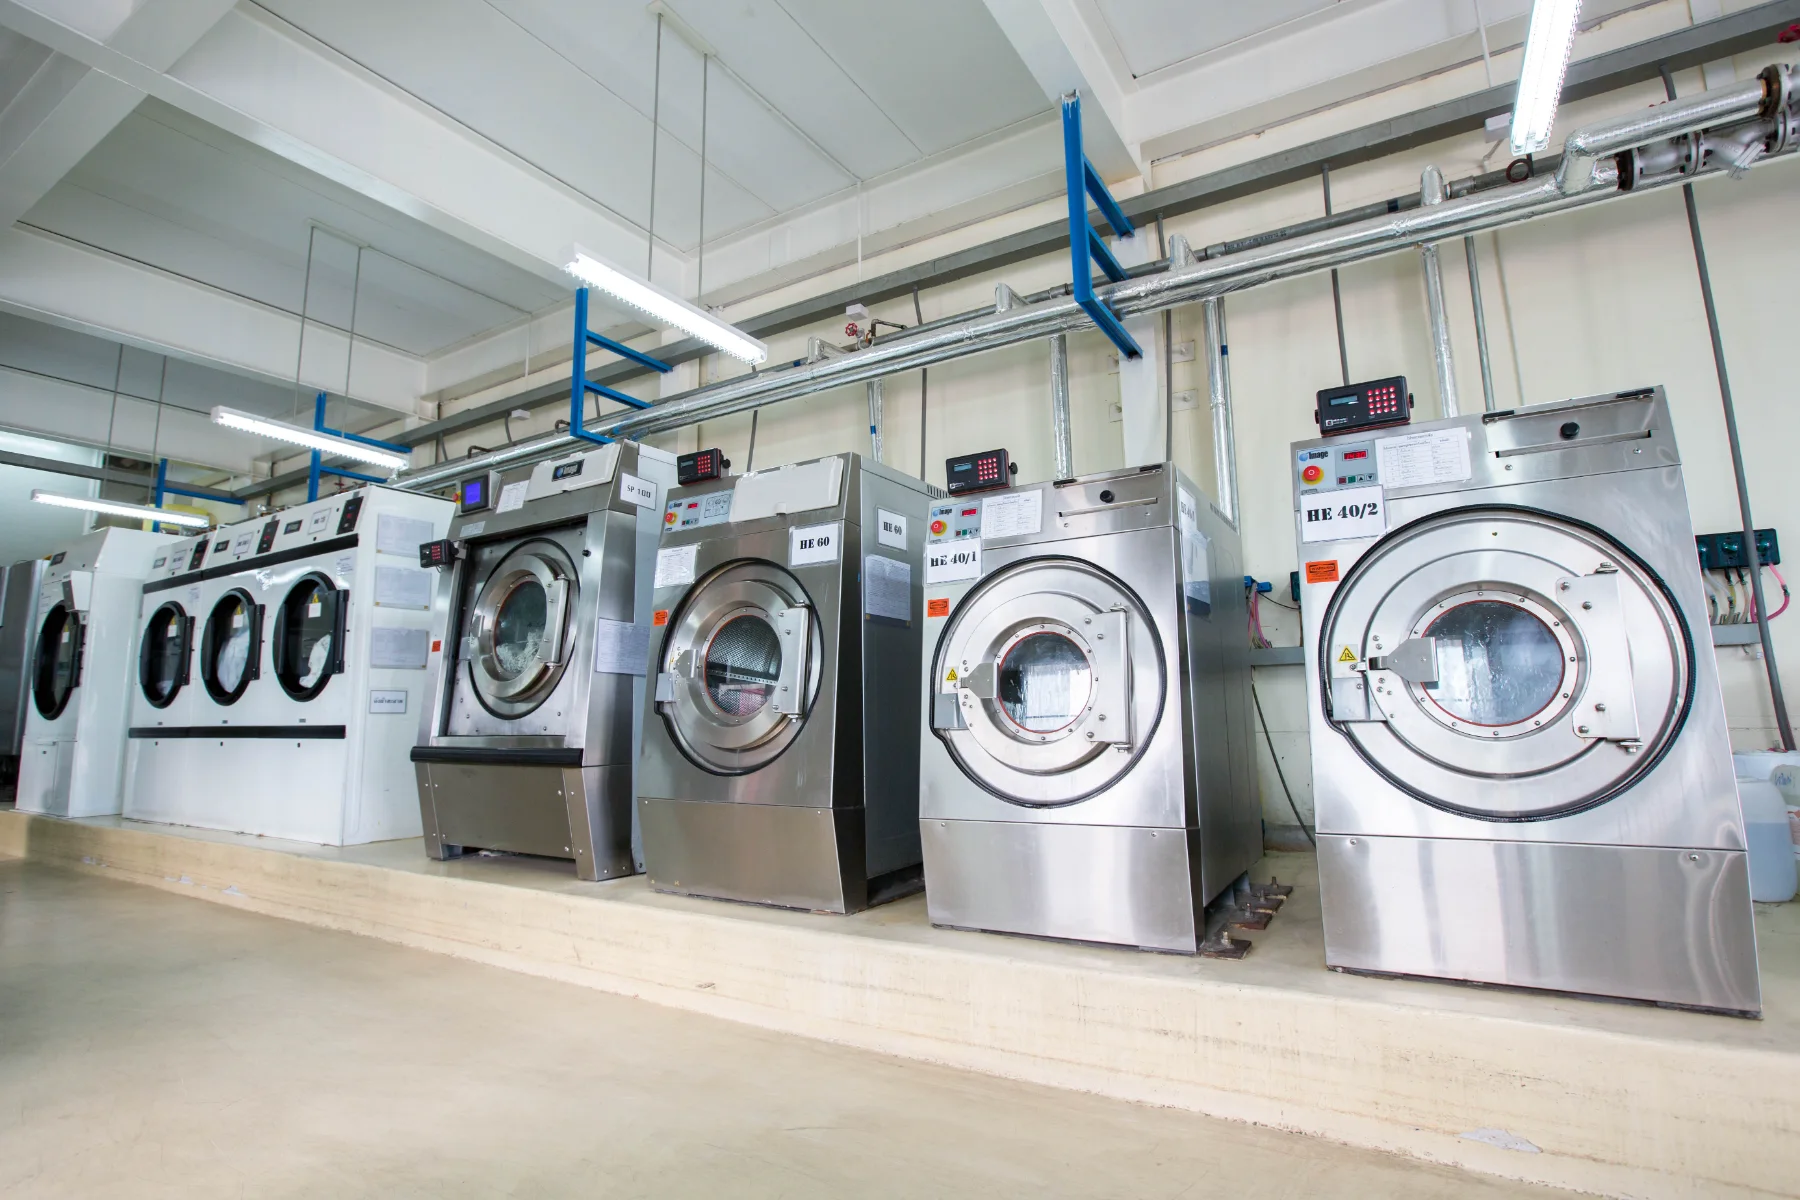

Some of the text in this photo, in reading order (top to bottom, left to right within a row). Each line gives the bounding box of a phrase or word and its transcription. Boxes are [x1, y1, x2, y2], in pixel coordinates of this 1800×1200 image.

[1309, 450, 1328, 459] Image
[627, 484, 651, 498] SP 100
[1307, 502, 1378, 522] HE 40/2
[883, 521, 903, 536] HE 60
[799, 536, 830, 550] HE 60
[930, 551, 977, 567] HE 40/1
